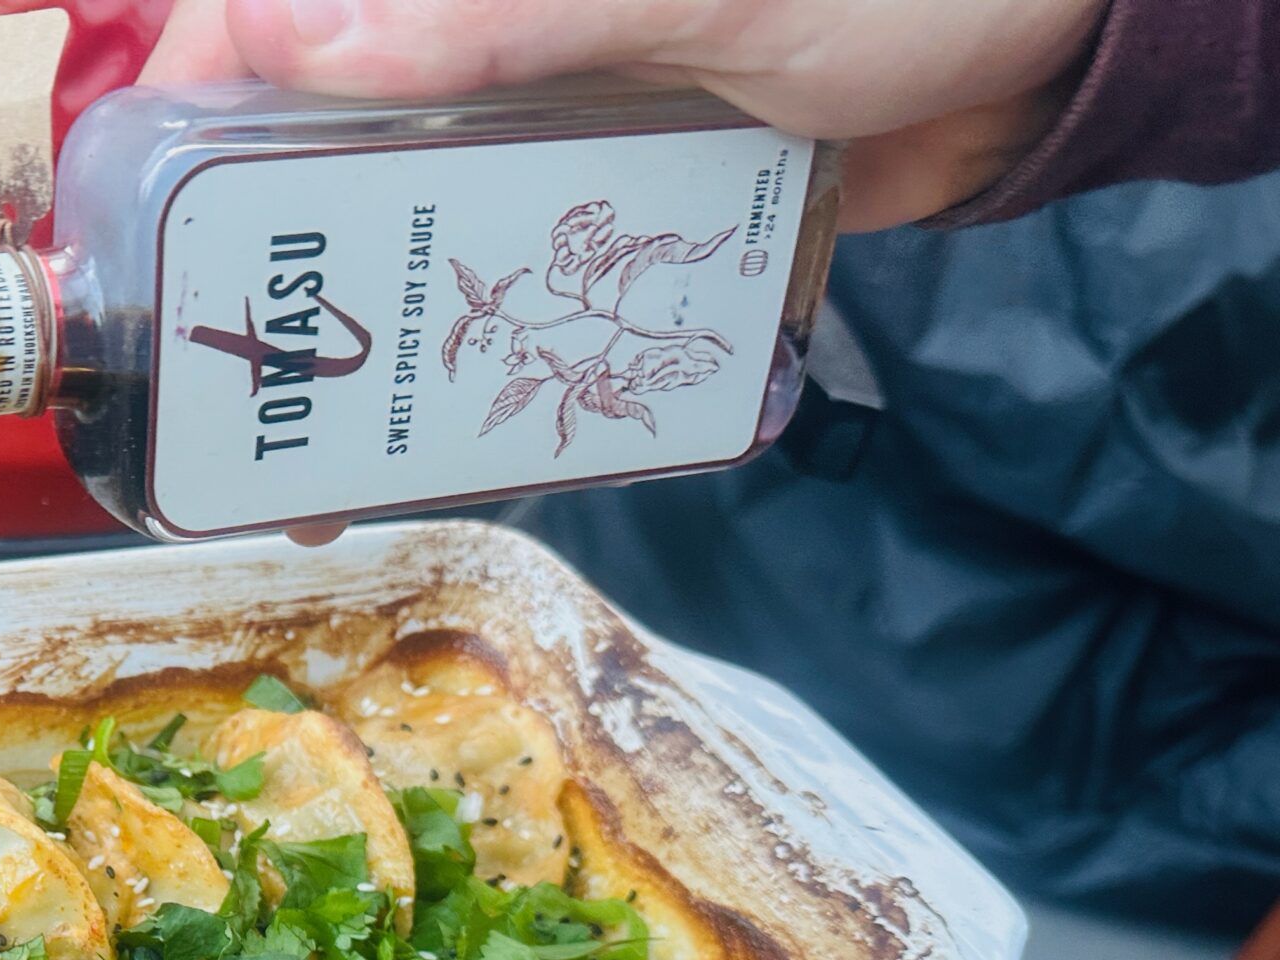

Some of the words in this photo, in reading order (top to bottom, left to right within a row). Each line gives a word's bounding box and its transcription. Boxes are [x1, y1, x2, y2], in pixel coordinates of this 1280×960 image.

[771, 149, 789, 205] months
[745, 169, 771, 244] FERMENTED
[407, 204, 436, 270] SAUCE
[402, 281, 427, 317] SOY
[22, 305, 36, 355] HOEKSCHE
[254, 231, 327, 461] TOMASU
[394, 328, 421, 384] SPICY
[23, 357, 36, 374] THE
[386, 393, 413, 455] SWEET
